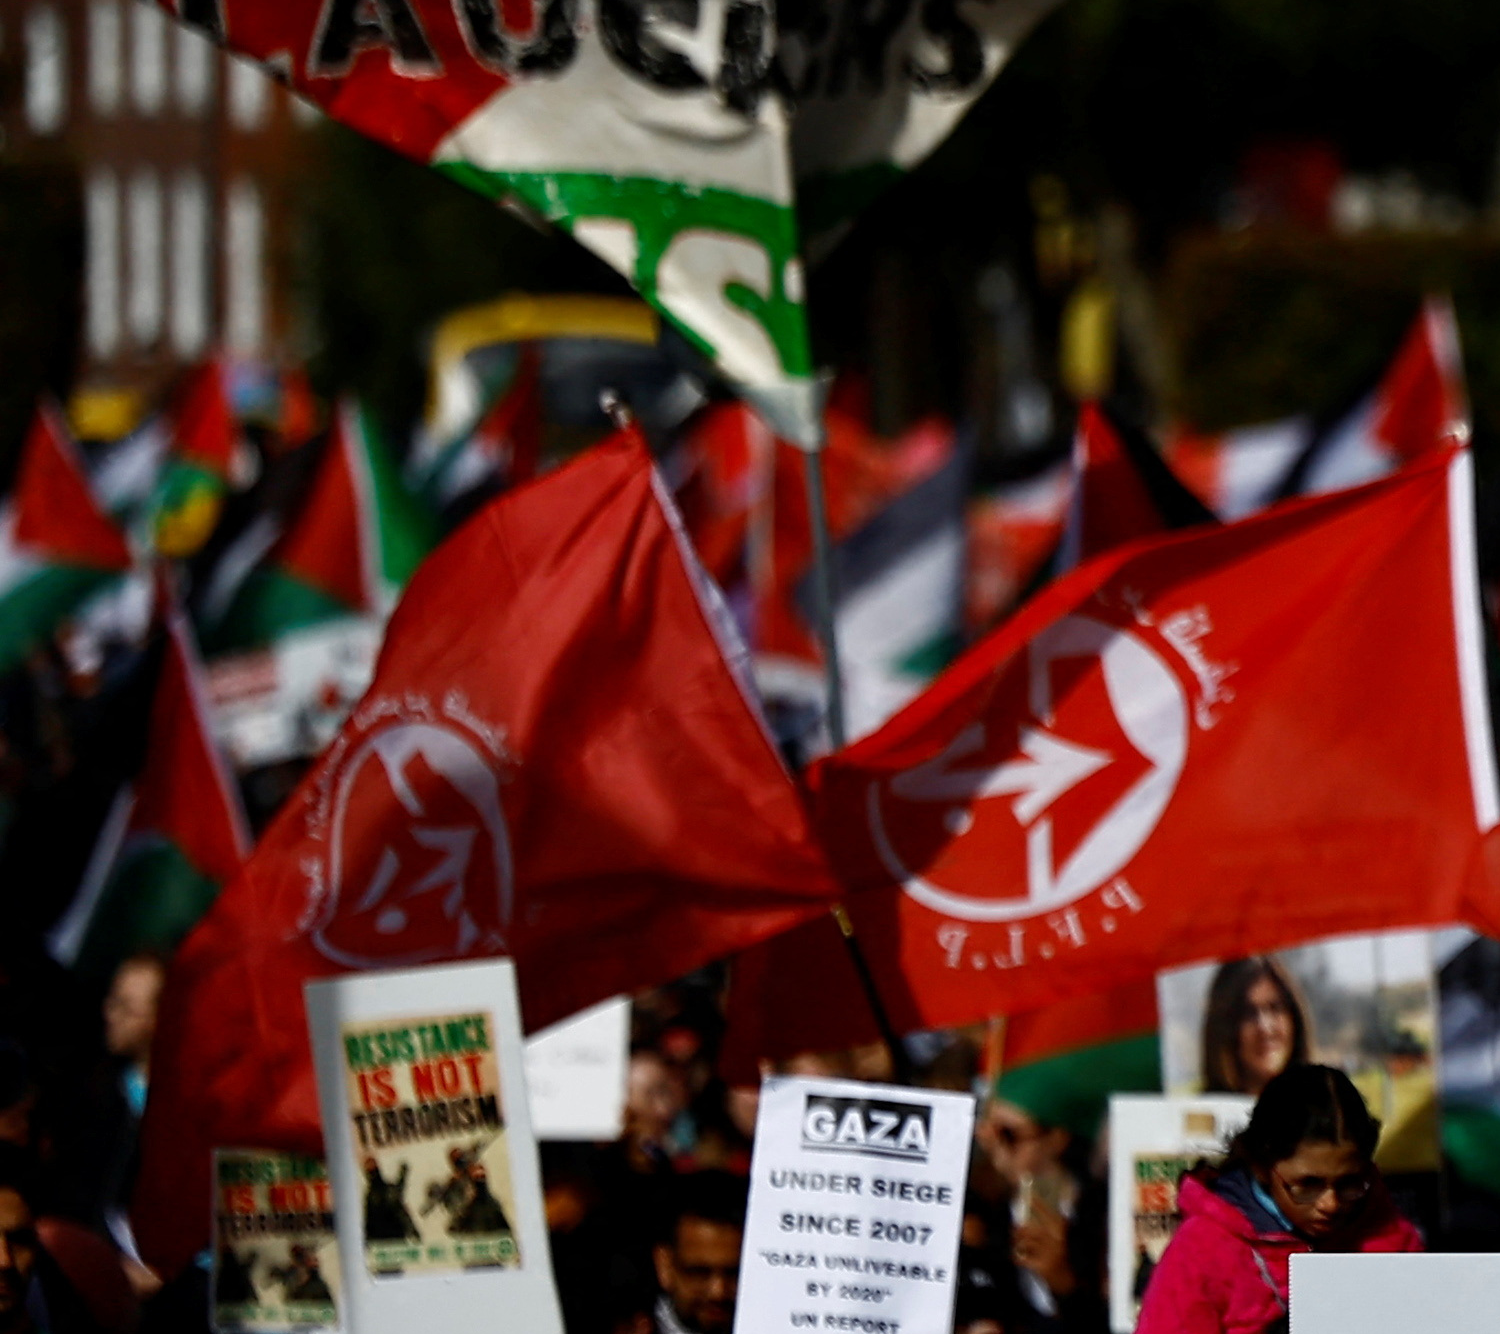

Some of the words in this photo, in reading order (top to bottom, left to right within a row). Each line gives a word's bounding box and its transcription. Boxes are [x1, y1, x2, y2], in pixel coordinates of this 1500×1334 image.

[343, 1016, 490, 1071] RESISTANCE
[357, 1069, 399, 1112] IS
[411, 1054, 485, 1103] NOT
[353, 1093, 506, 1149] TERRORISM
[803, 1105, 928, 1150] GAZA
[769, 1169, 861, 1194] UNDER
[871, 1178, 953, 1205] SIEGE
[780, 1214, 860, 1237] SINCE
[870, 1221, 933, 1246] 2007
[806, 1281, 831, 1298] BY
[790, 1312, 816, 1328] UN
